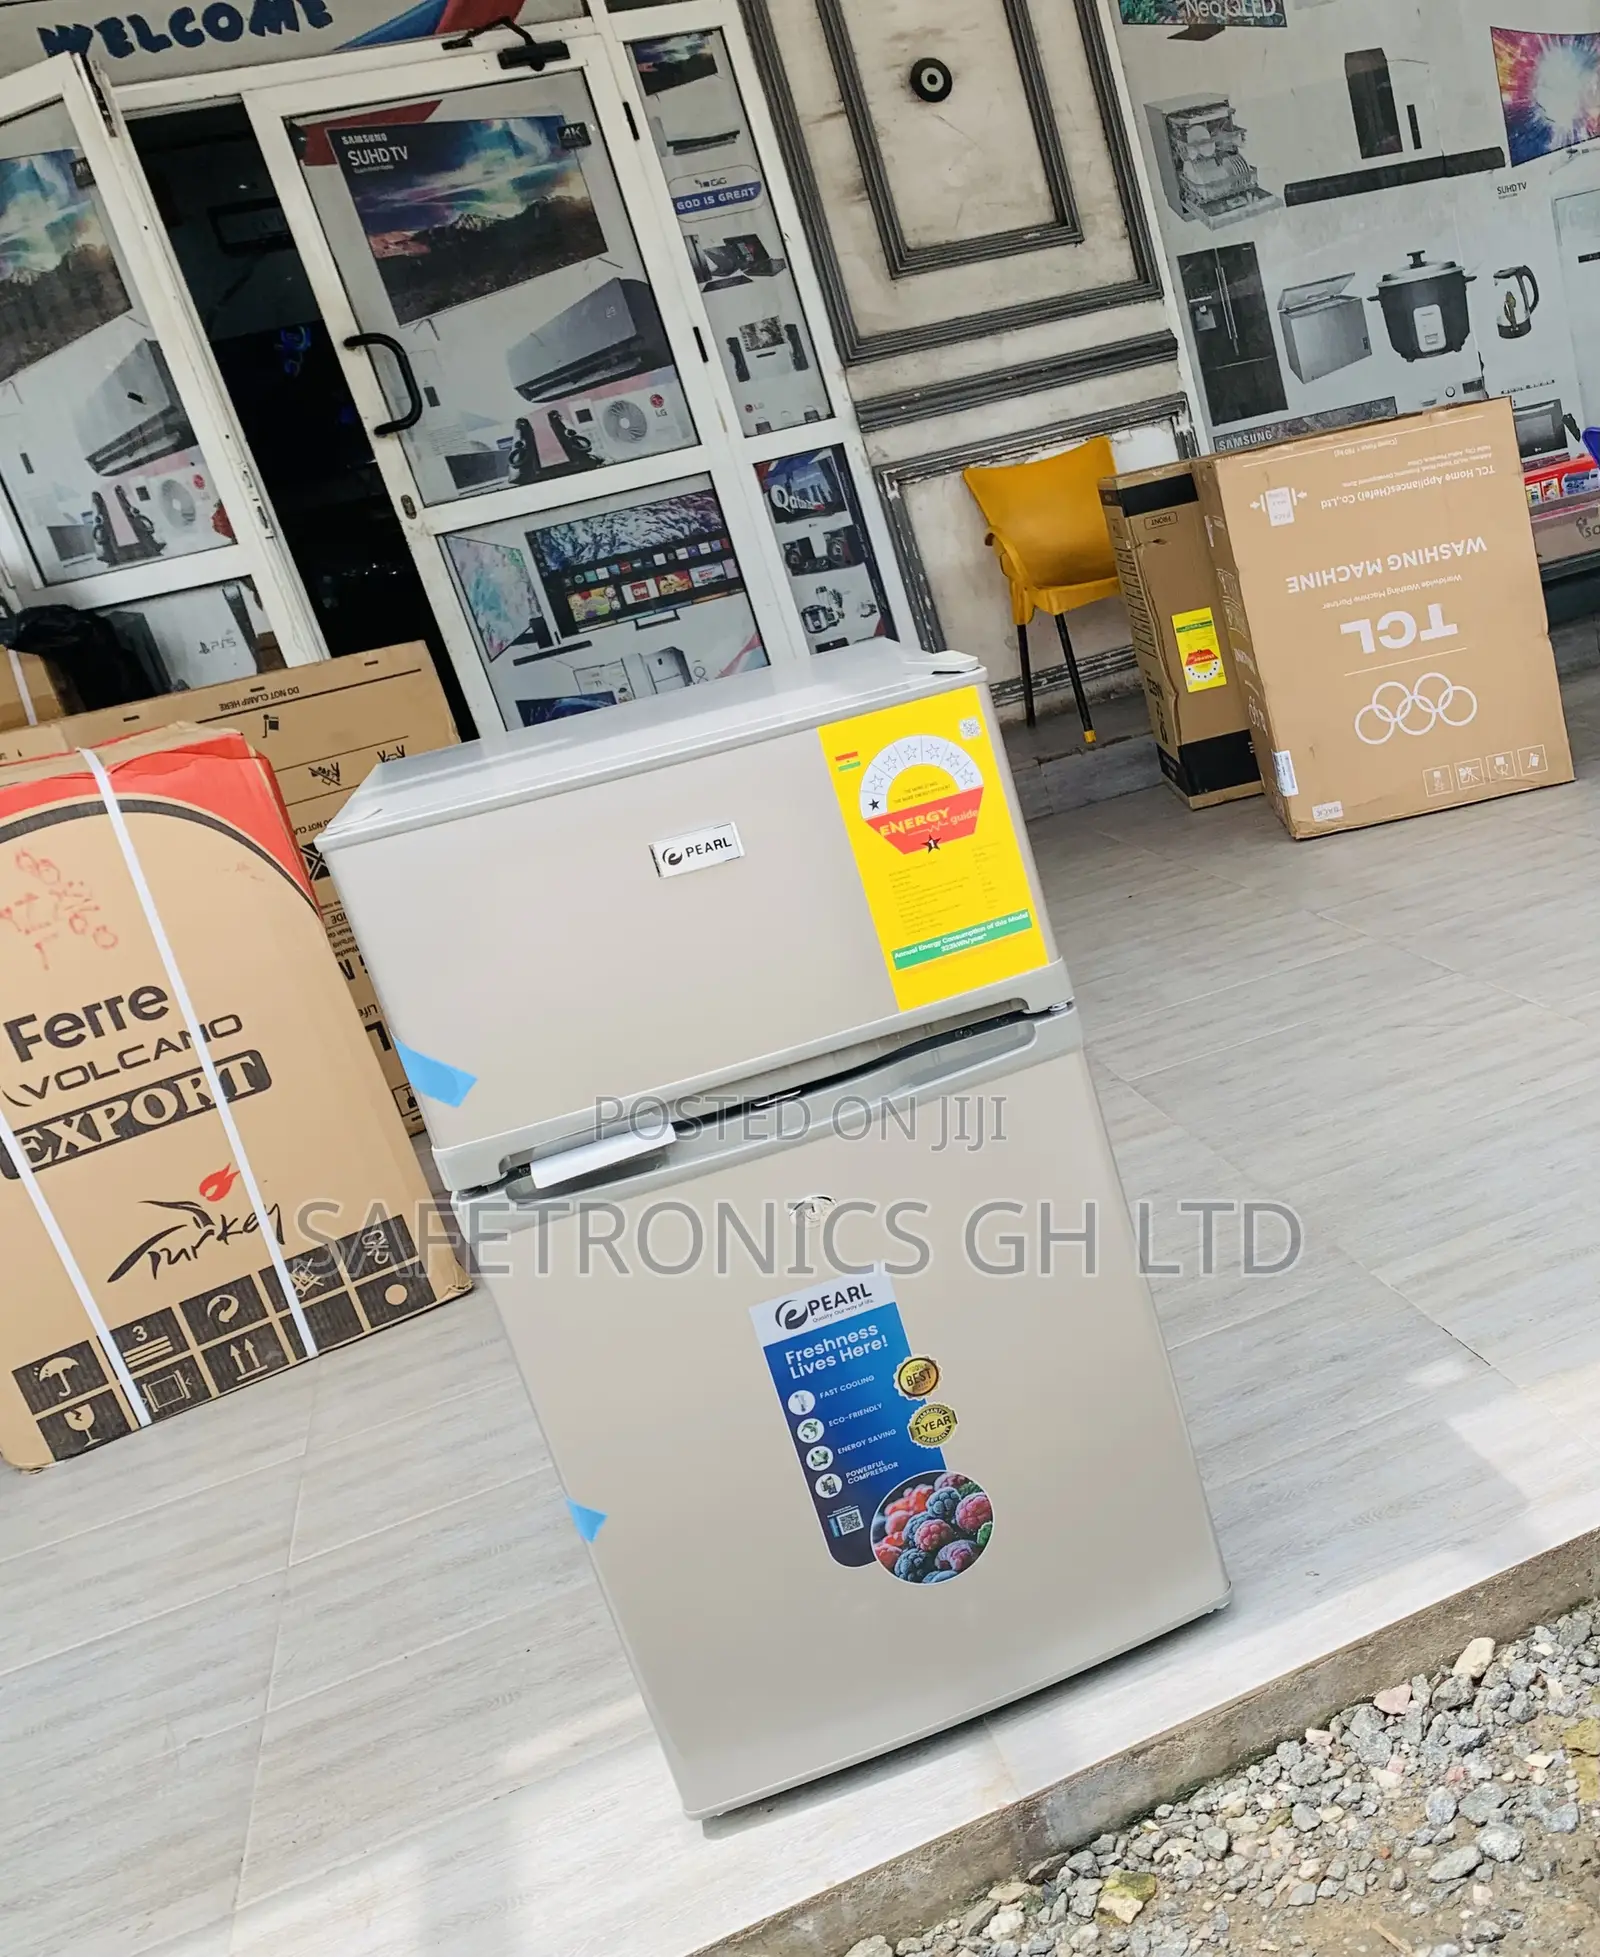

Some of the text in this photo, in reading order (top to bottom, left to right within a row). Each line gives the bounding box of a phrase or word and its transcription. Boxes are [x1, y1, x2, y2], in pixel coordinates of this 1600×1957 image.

[37, 0, 334, 58] WELCOME
[341, 133, 387, 145] SAMSUNG
[676, 187, 755, 210] GOD IS GREAT
[1218, 430, 1273, 451] SAMSUNG
[1445, 468, 1474, 482] Home
[1475, 464, 1496, 476] TCL
[1286, 536, 1488, 594] WASHING MACHINE
[1322, 573, 1462, 610] Worldwide Washing Machine Partner
[1339, 602, 1459, 655] TCL
[218, 686, 300, 712] DO NOT CLAMP HERE
[307, 821, 323, 832] NOT
[879, 806, 979, 837] ENERGY guide
[685, 837, 732, 858] PEARL
[894, 911, 1029, 960] Annual Energy Consumption of this Model
[3, 985, 169, 1063] Ferre
[19, 1014, 243, 1100] VOLCANO
[14, 1055, 260, 1169] EXPORT
[807, 1283, 872, 1316] PEARL
[132, 1325, 148, 1342] 3
[785, 1324, 878, 1365] Freshness
[789, 1334, 888, 1380] Lives Here!
[820, 1374, 875, 1399] FAST COOLING
[905, 1367, 932, 1387] BEST
[828, 1402, 882, 1428] ECO-FRIENDLY
[921, 1415, 952, 1433] YEAR
[837, 1428, 897, 1455] ENERGY SAVING
[845, 1460, 885, 1479] POWERFUL
[847, 1461, 899, 1485] COMPRESSOR
